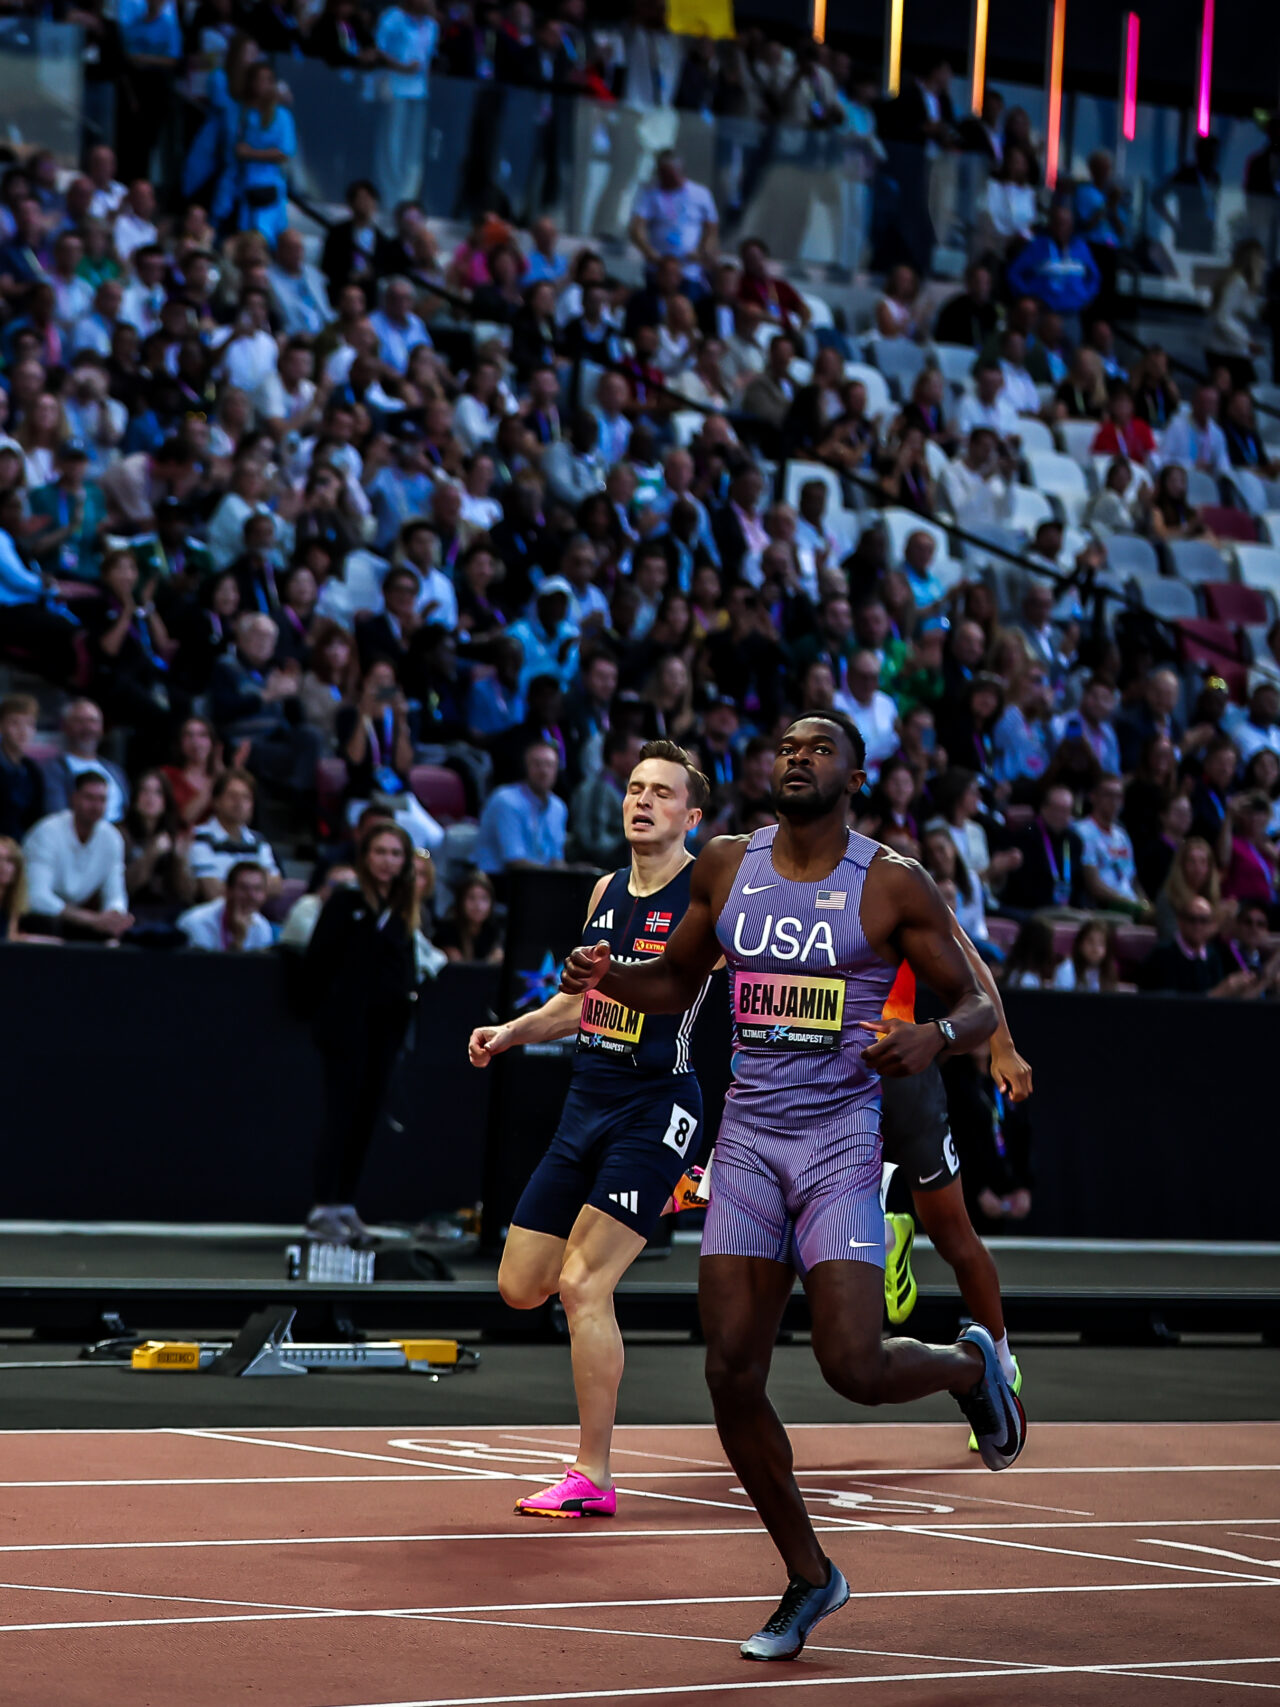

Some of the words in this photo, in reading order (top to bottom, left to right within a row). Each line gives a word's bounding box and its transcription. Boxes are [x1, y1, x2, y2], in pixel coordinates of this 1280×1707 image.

[733, 912, 837, 966] USA
[739, 983, 839, 1021] BENJAMIN
[742, 1028, 767, 1039] ULTIMATE
[788, 1032, 823, 1043] BUDAPEST
[674, 1117, 690, 1148] 8
